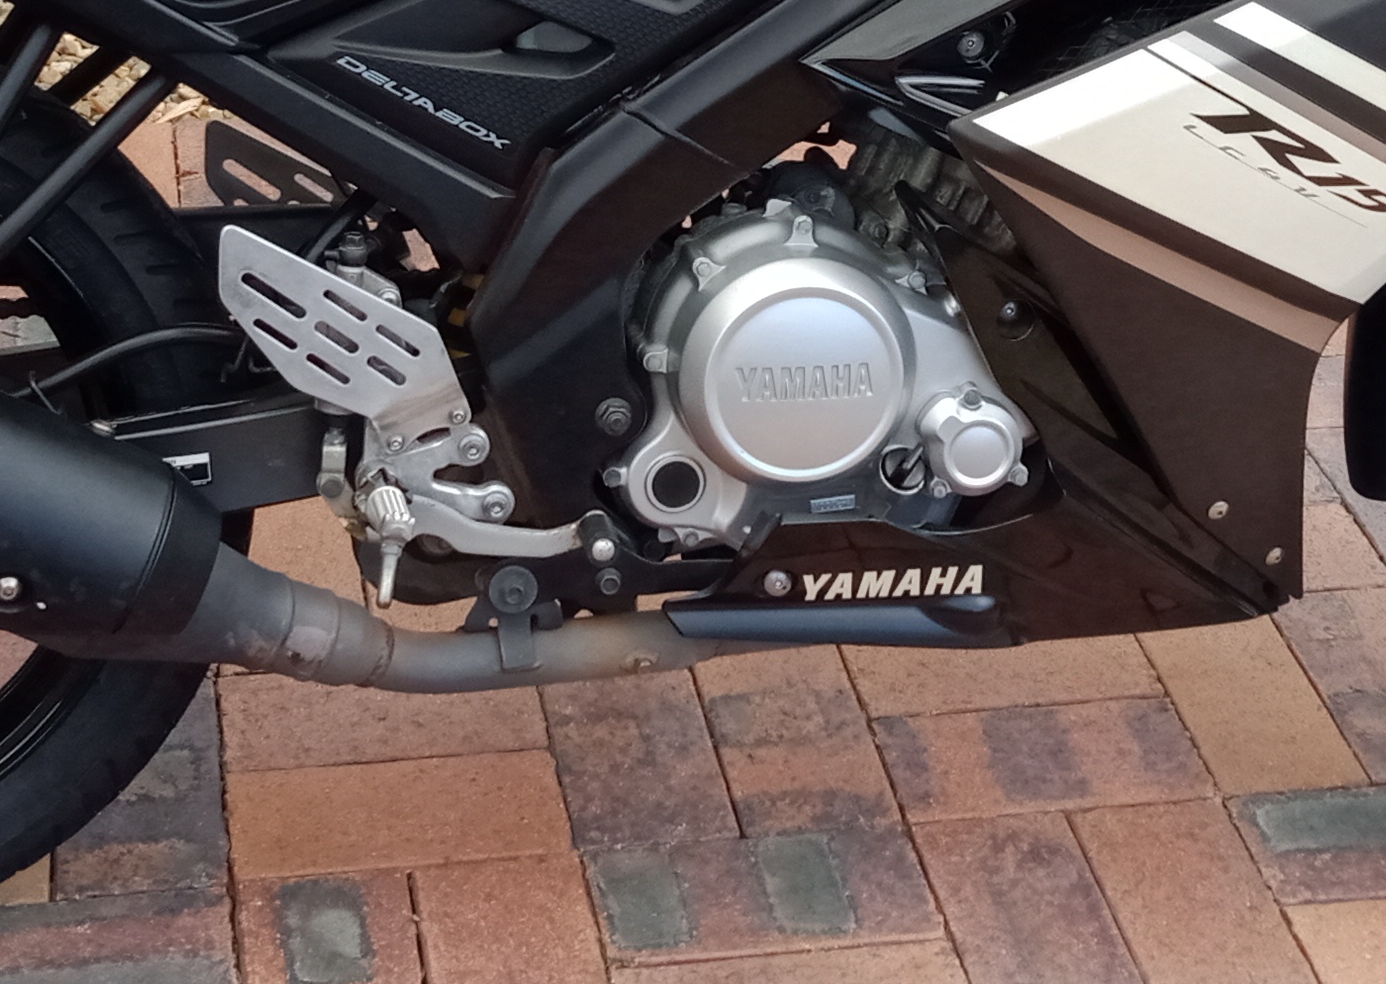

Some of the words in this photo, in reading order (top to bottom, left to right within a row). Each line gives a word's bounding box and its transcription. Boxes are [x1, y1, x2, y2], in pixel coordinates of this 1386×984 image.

[336, 55, 512, 150] DELTABOX
[735, 362, 874, 402] YAMAHA
[802, 565, 984, 603] YAMAHA
